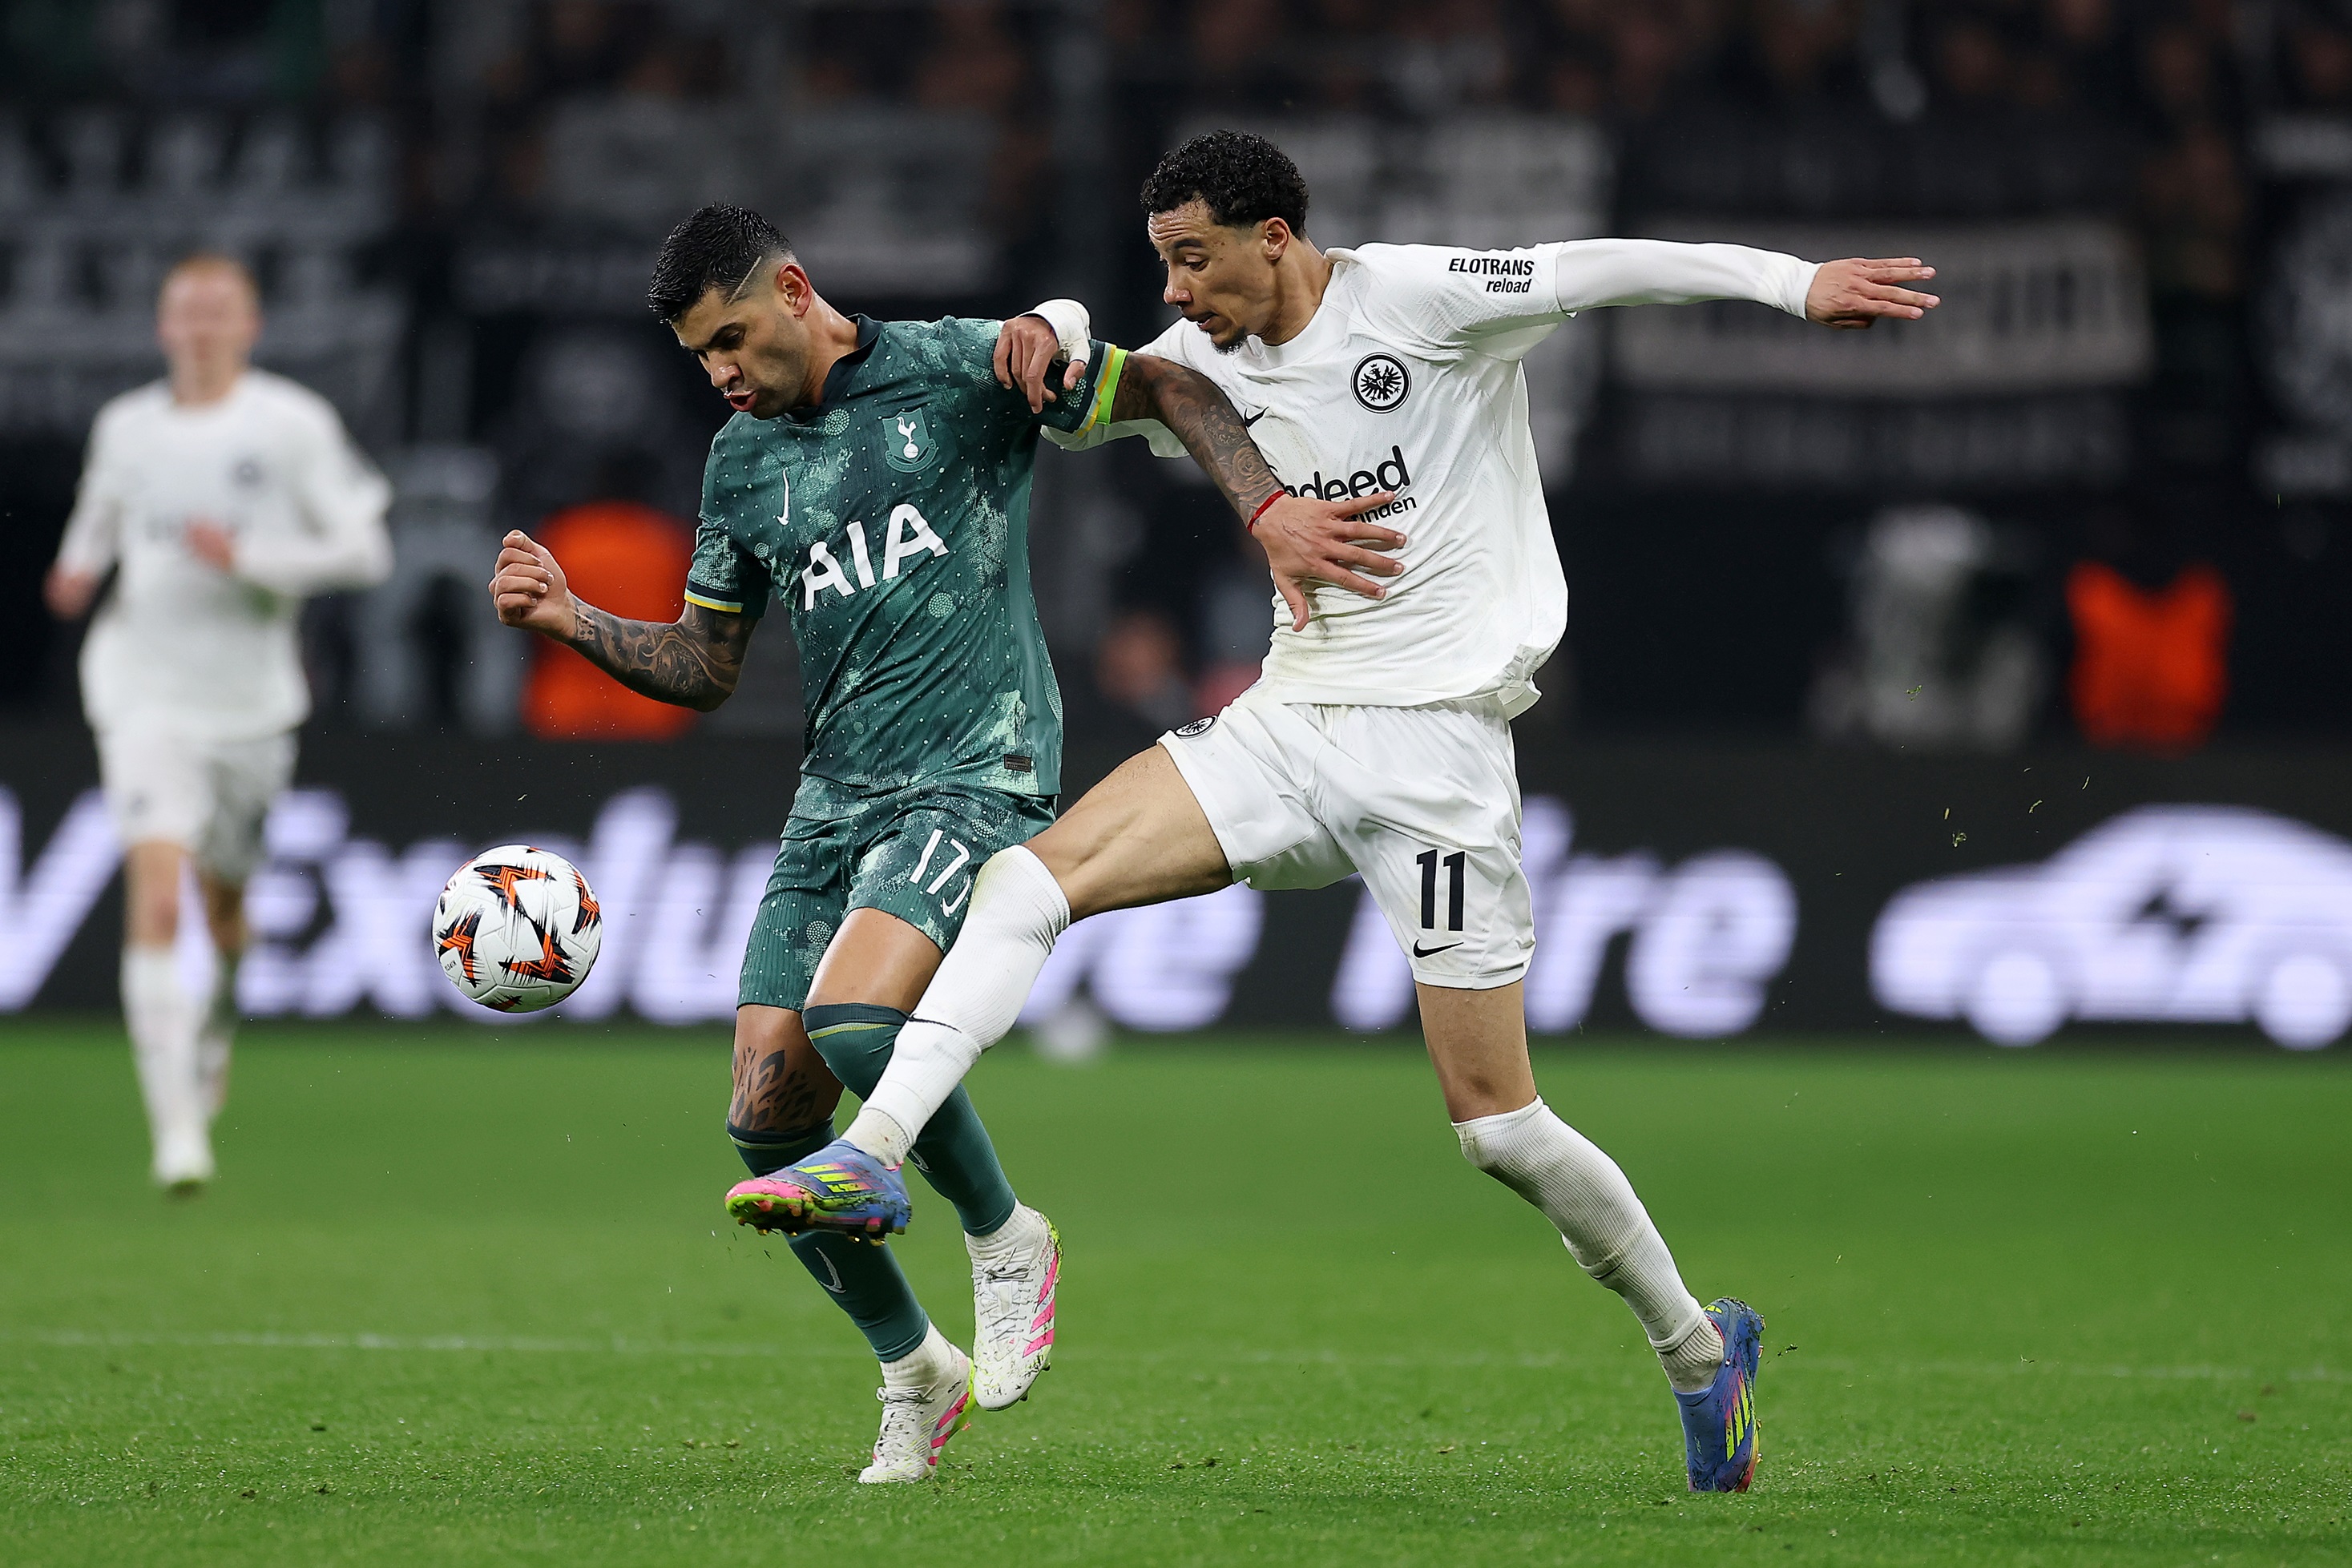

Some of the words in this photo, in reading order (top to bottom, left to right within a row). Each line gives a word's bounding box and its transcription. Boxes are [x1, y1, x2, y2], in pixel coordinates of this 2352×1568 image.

[1448, 258, 1535, 276] ELOTRANS
[1486, 278, 1532, 293] reload
[1282, 445, 1410, 502] deed
[1344, 496, 1417, 523] inden
[802, 503, 950, 611] AIA
[909, 828, 970, 895] 17
[1416, 849, 1466, 932] 11
